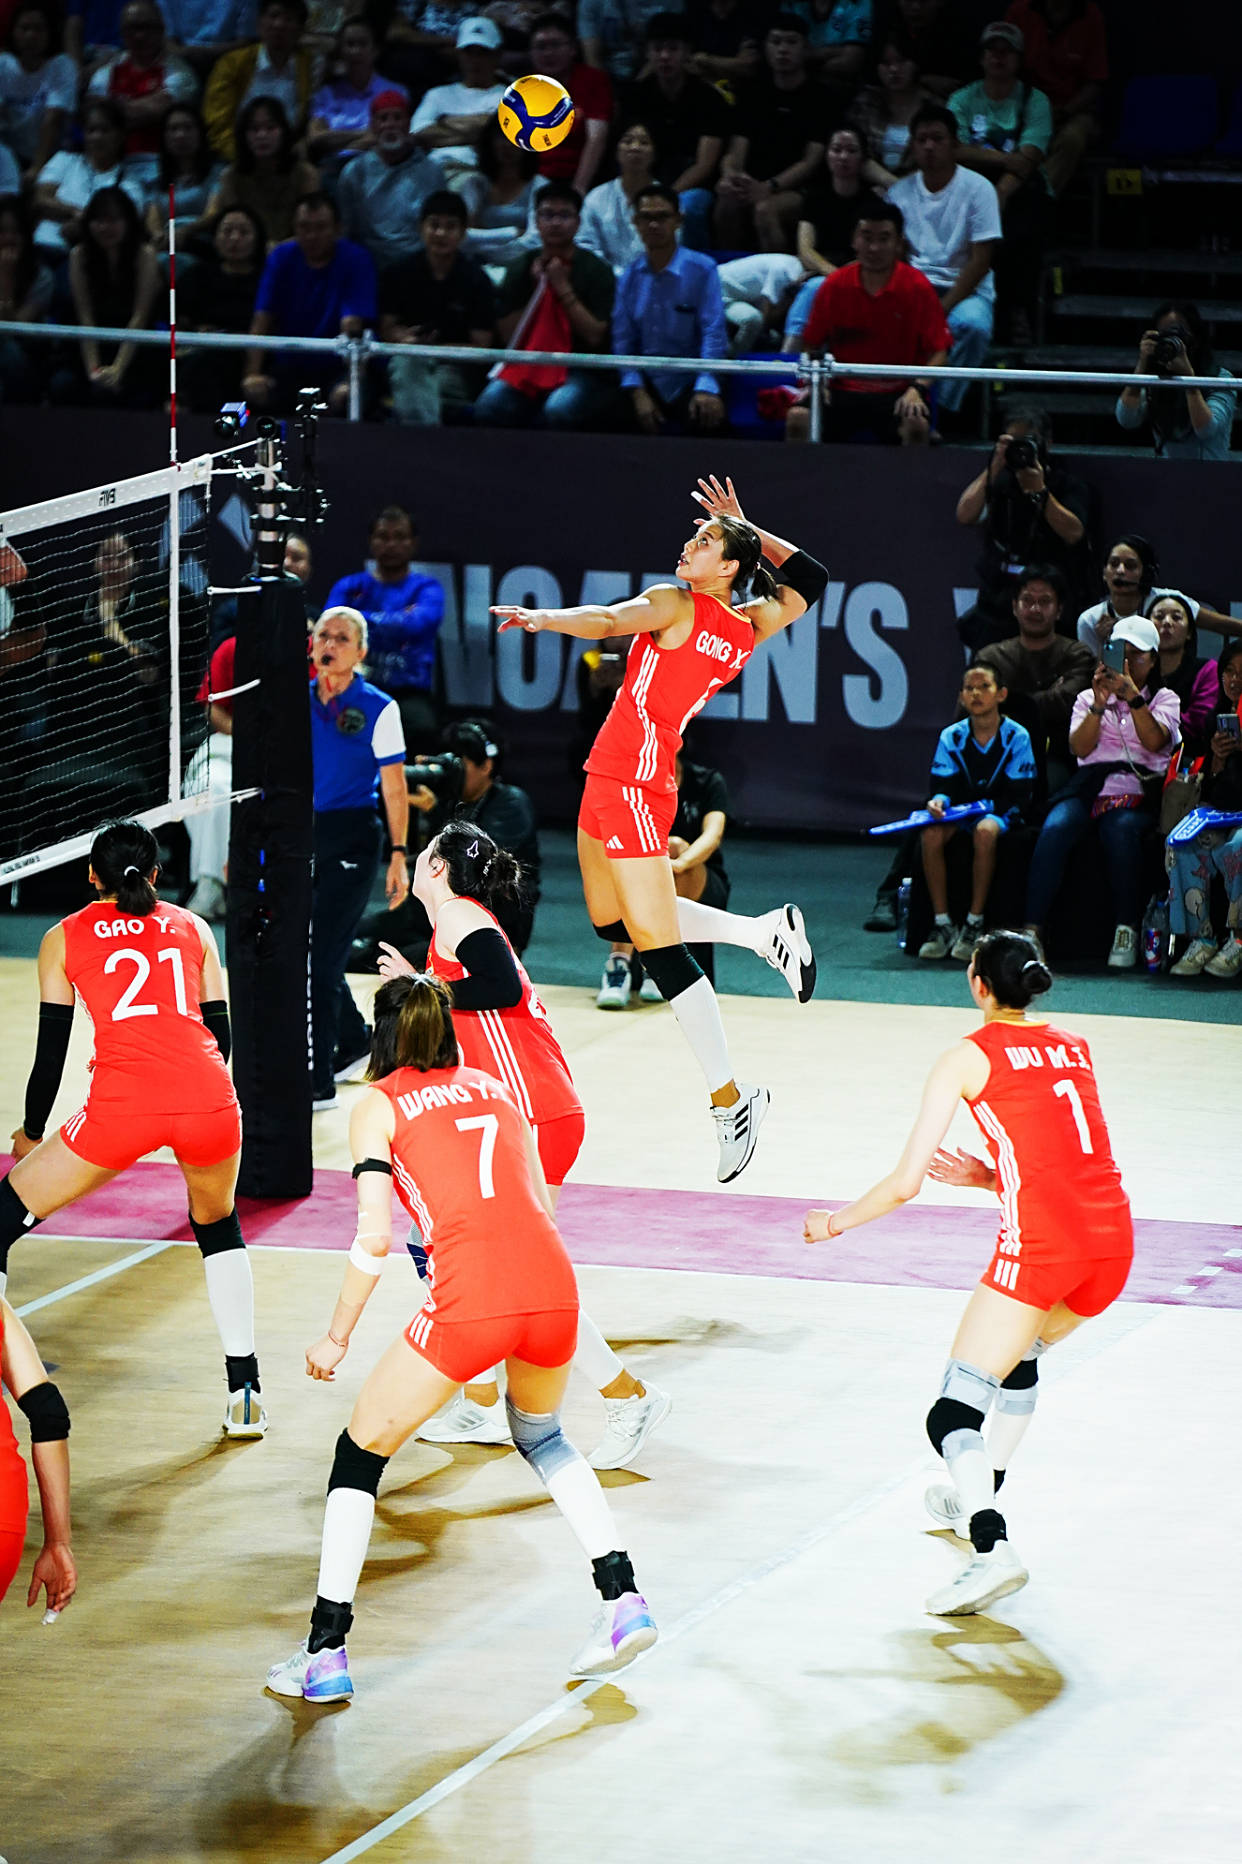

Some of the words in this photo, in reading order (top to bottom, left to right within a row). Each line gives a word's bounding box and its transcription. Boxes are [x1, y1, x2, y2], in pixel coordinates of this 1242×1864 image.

[366, 558, 909, 730] WON'S
[695, 629, 733, 663] GONG
[94, 918, 144, 939] GAO
[152, 916, 176, 935] Y.
[104, 947, 189, 1022] 21
[1004, 1046, 1044, 1071] WU
[397, 1083, 473, 1121] WANG
[1052, 1079, 1094, 1155] 1
[454, 1114, 500, 1200] 7
